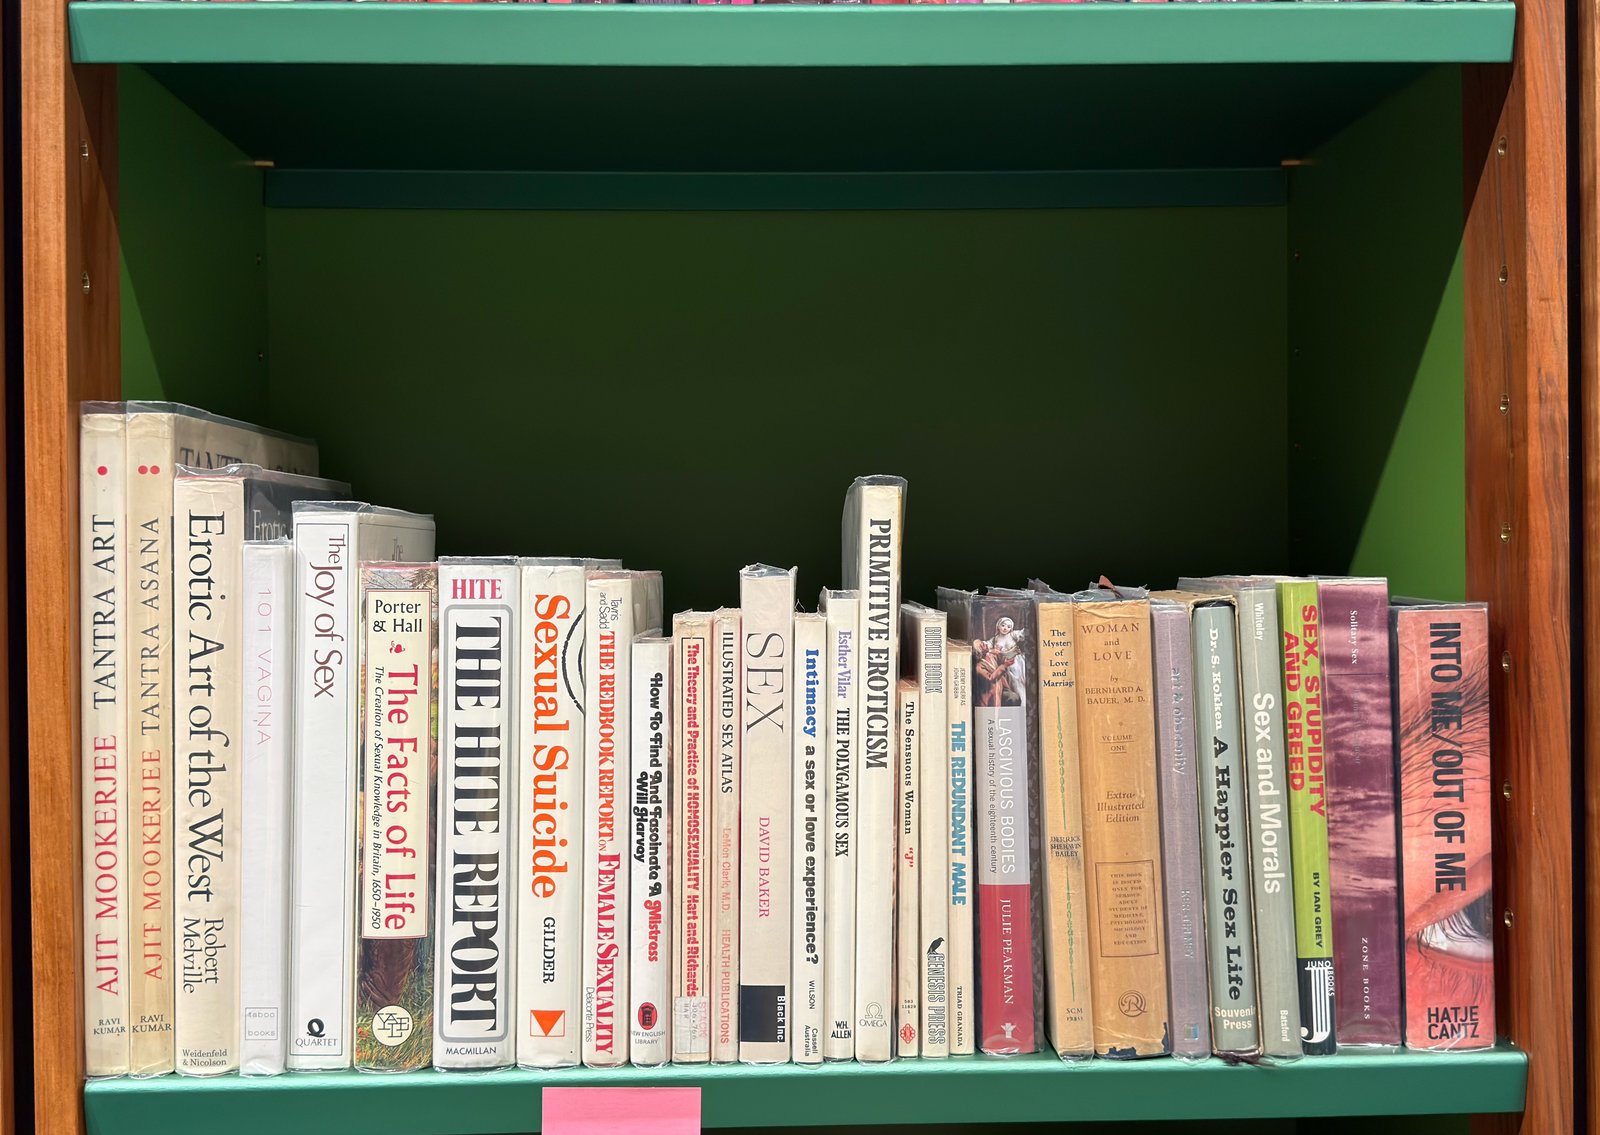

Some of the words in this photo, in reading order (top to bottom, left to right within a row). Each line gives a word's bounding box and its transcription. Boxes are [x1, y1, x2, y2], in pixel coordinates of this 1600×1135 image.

[92, 514, 116, 574] ART
[140, 517, 160, 611] ASANA
[327, 533, 347, 564] The
[187, 509, 226, 622] Erotic
[305, 562, 344, 608] Joy
[868, 518, 892, 641] PRIMITIVE
[375, 599, 422, 615] Porter
[451, 578, 503, 600] HITE
[257, 588, 273, 635] 101
[314, 612, 345, 642] of
[372, 620, 387, 633] &
[392, 618, 423, 633] Hall
[609, 598, 623, 621] Tavris
[1081, 622, 1140, 635] WOMAN
[1254, 602, 1265, 641] Whiteley
[1348, 610, 1358, 646] Solitary
[92, 586, 117, 710] TANTRA
[599, 630, 616, 671] THE
[838, 630, 852, 669] Esther
[1050, 629, 1066, 637] The
[1054, 649, 1064, 657] of
[1104, 638, 1120, 647] and
[1302, 604, 1320, 666] SEX,
[1429, 622, 1463, 683] INTO
[187, 632, 226, 697] Art
[314, 649, 344, 699] Sex
[454, 616, 502, 711] THE
[533, 594, 571, 735] Sexual
[687, 644, 700, 665] The
[1049, 659, 1069, 667] Love
[1052, 669, 1067, 677] and
[1093, 650, 1133, 662] LOVE
[1284, 630, 1301, 692] AND
[1351, 648, 1359, 665] Sex
[140, 624, 160, 736] TANTRA
[387, 664, 418, 725] The
[650, 672, 663, 709] How
[686, 665, 700, 705] Theory
[722, 632, 734, 718] ILLUSTRATED
[746, 632, 785, 734] SEX
[803, 649, 820, 738] Intimacy
[837, 670, 852, 699] Vilar
[1085, 686, 1134, 695] BERNHARD
[1135, 685, 1144, 693] A.
[1110, 675, 1119, 684] by
[257, 649, 273, 747] VAGINA
[687, 706, 700, 728] and
[865, 647, 889, 769] EROTICISM
[904, 701, 915, 725] The
[1253, 692, 1275, 743] Sex
[188, 704, 230, 748] of
[599, 671, 616, 769] REDBOOK
[649, 711, 663, 731] To
[722, 724, 733, 748] SEX
[836, 707, 851, 736] THE
[951, 721, 967, 752] THE
[1101, 734, 1133, 742] VOLUME
[649, 732, 663, 768] Find
[687, 731, 700, 776] Practice
[805, 745, 816, 756] a
[904, 728, 915, 787] Sensuous
[999, 718, 1015, 809] LASCIVIOUS
[1213, 736, 1229, 759] A
[1287, 701, 1306, 792] GREED
[1304, 675, 1326, 817] STUPIDITY
[1431, 692, 1465, 802] ME/OUT
[187, 749, 227, 808] the
[386, 737, 418, 814] Facts
[453, 723, 502, 836] HITE
[636, 771, 649, 804] Will
[649, 770, 663, 804] And
[687, 777, 700, 790] of
[721, 752, 733, 793] ATLAS
[805, 759, 816, 790] sex
[835, 739, 850, 829] POLYGAMOUS
[1256, 745, 1280, 797] and
[598, 769, 616, 840] REPORT
[805, 793, 816, 813] or
[904, 789, 914, 835] Woman
[951, 756, 967, 857] REDUNDANT
[1096, 800, 1145, 812] Illustrated
[1106, 790, 1137, 800] Extra-
[93, 735, 118, 920] MOOKERJEE
[141, 749, 162, 911] MOOKERJEE
[531, 744, 570, 898] Suicide
[633, 806, 648, 863] Harvey
[805, 816, 818, 853] love
[1105, 813, 1140, 824] Edition
[1214, 765, 1235, 881] Happier
[1433, 810, 1466, 844] OF
[187, 808, 225, 902] West
[385, 825, 416, 859] of
[598, 840, 608, 852] ON
[648, 806, 662, 880] Fascinate
[687, 792, 700, 891] HOMOSEXUALITY
[758, 816, 771, 863] DAVID
[835, 832, 849, 858] SEX
[1000, 815, 1015, 874] BODIES
[1259, 803, 1286, 894] Morals
[648, 881, 662, 897] A
[758, 867, 770, 918] BAKER
[951, 862, 967, 906] MALE
[1312, 872, 1320, 888] BY
[1434, 852, 1467, 894] ME
[384, 873, 416, 931] Life
[597, 852, 621, 941] FEMALE
[687, 895, 699, 920] Hart
[803, 856, 819, 964] experience?
[1222, 888, 1238, 938] Sex
[1313, 891, 1321, 914] IAN
[643, 899, 662, 963] Mistress
[687, 922, 699, 944] and
[1000, 899, 1012, 935] JULIE
[1314, 916, 1323, 949] GREY
[143, 922, 163, 981] AJIT
[182, 917, 204, 994] Melville
[204, 917, 227, 985] Robert
[450, 849, 500, 1032] REPORT
[542, 916, 557, 984] GILDER
[1361, 937, 1370, 971] ZONE
[96, 934, 119, 995] AJIT
[687, 946, 699, 997] Richards
[928, 953, 945, 1003] GENESIS
[1001, 938, 1014, 1005] PEAKMAN
[1226, 945, 1244, 1001] Life
[1327, 969, 1335, 997] BOOKS
[595, 942, 620, 1055] SEXUALITY
[808, 980, 816, 1010] WILSON
[1362, 978, 1371, 1021] BOOKS
[1427, 1005, 1480, 1023] HATJE
[93, 1026, 127, 1036] KUMAR
[98, 1017, 121, 1026] RAVI
[132, 1023, 173, 1033] KUMAR
[140, 1014, 164, 1024] RAVI
[830, 1029, 852, 1039] ALLEN
[859, 1019, 888, 1028] OMEGA
[928, 1005, 946, 1045] PRESS
[1223, 1019, 1252, 1030] Press
[1279, 1009, 1290, 1042] Batsford
[1427, 1022, 1480, 1040] CANTZ
[182, 1048, 228, 1058] Weidenfeld
[295, 1038, 338, 1048] QUARTET
[446, 1046, 497, 1056] MACMILLAN
[804, 1025, 812, 1057] Australia
[811, 1028, 819, 1054] Cassell
[182, 1058, 189, 1067] &
[190, 1058, 227, 1067] Nicolson
